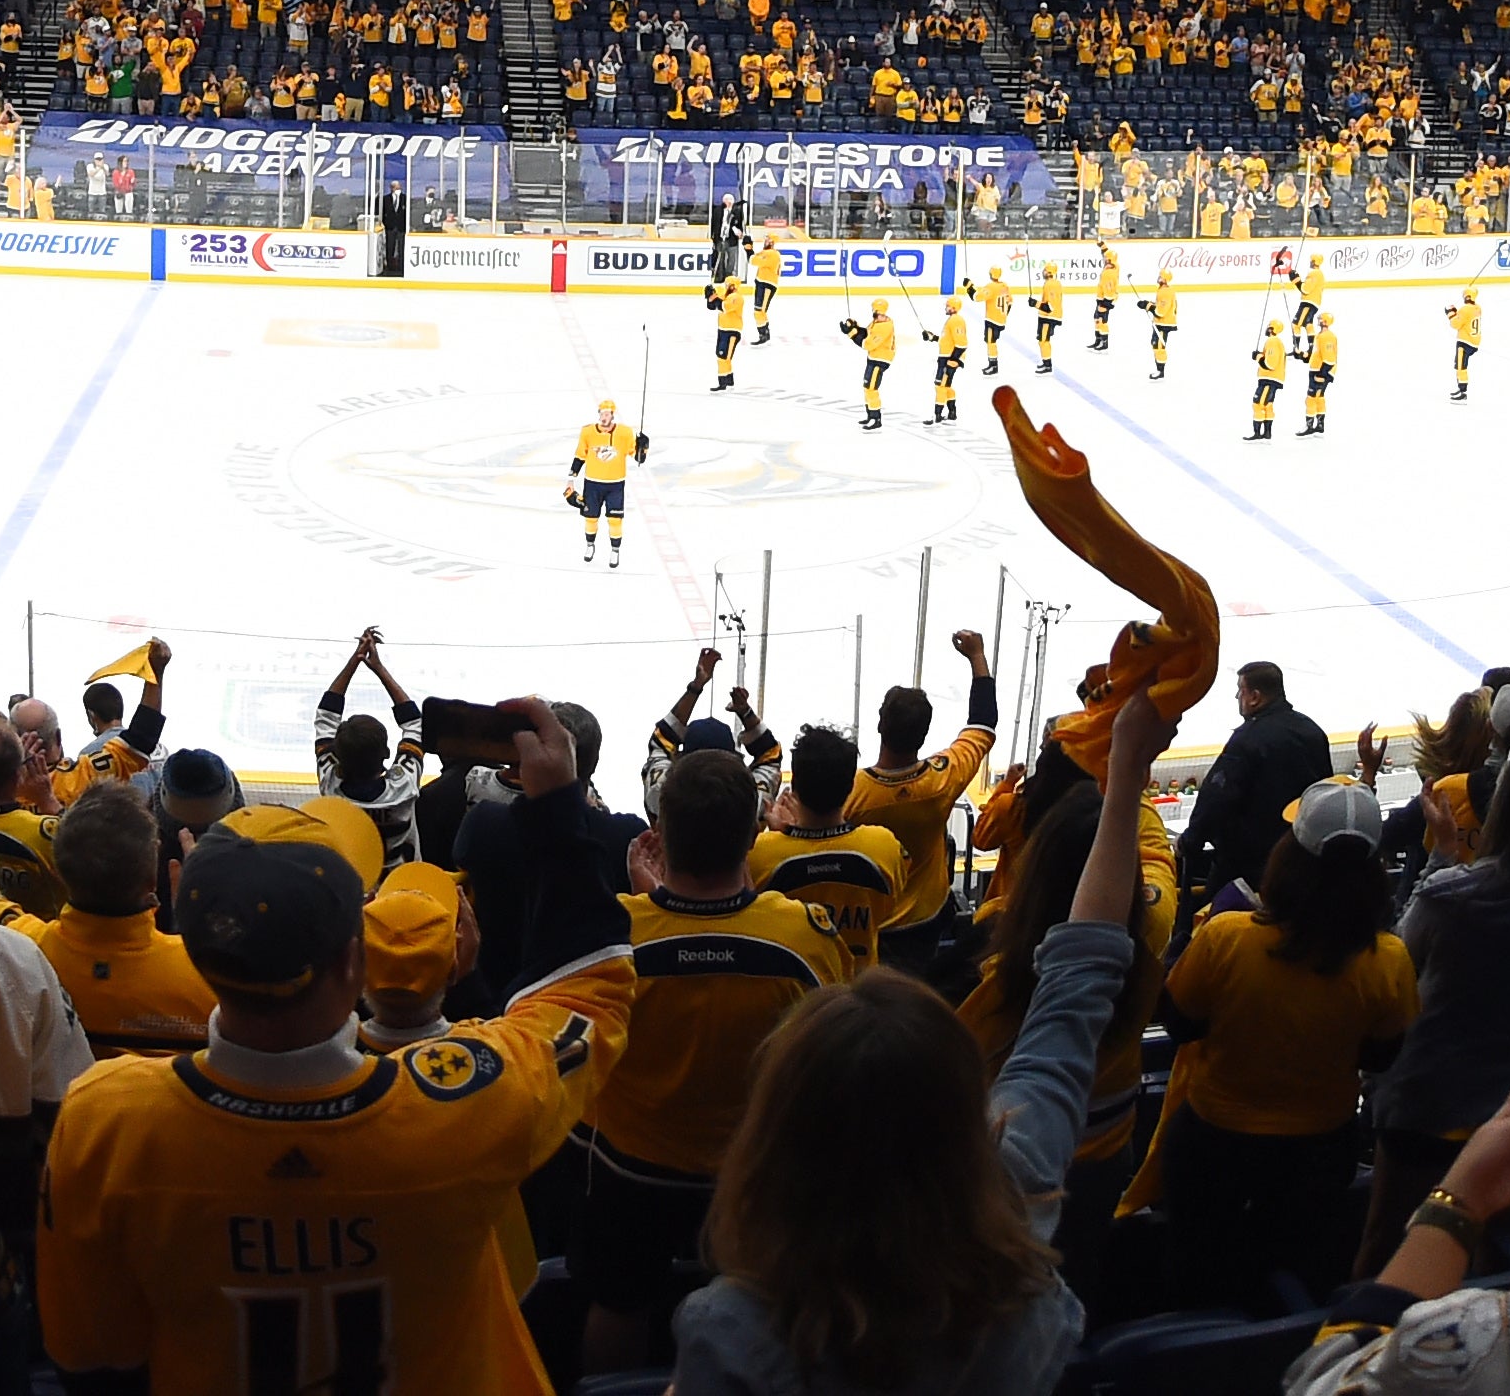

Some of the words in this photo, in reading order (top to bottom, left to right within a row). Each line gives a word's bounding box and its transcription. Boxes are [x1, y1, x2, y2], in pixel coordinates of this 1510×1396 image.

[67, 119, 482, 160] BRIDGESTONE
[611, 137, 1006, 168] BRIDGESTONE
[202, 153, 352, 178] ARENA
[747, 166, 905, 190] ARENA
[188, 233, 249, 254] 253
[189, 253, 249, 266] MILLION
[410, 244, 522, 270] Jägermeister
[593, 252, 649, 271] BUD
[654, 253, 714, 272] LIGH
[778, 248, 924, 277] GEICO
[1157, 245, 1218, 273] Bally
[1219, 254, 1262, 268] SPORTS
[677, 948, 735, 964] Reebok
[208, 1088, 357, 1116] NASHVILLE
[229, 1214, 379, 1275] ELLIS
